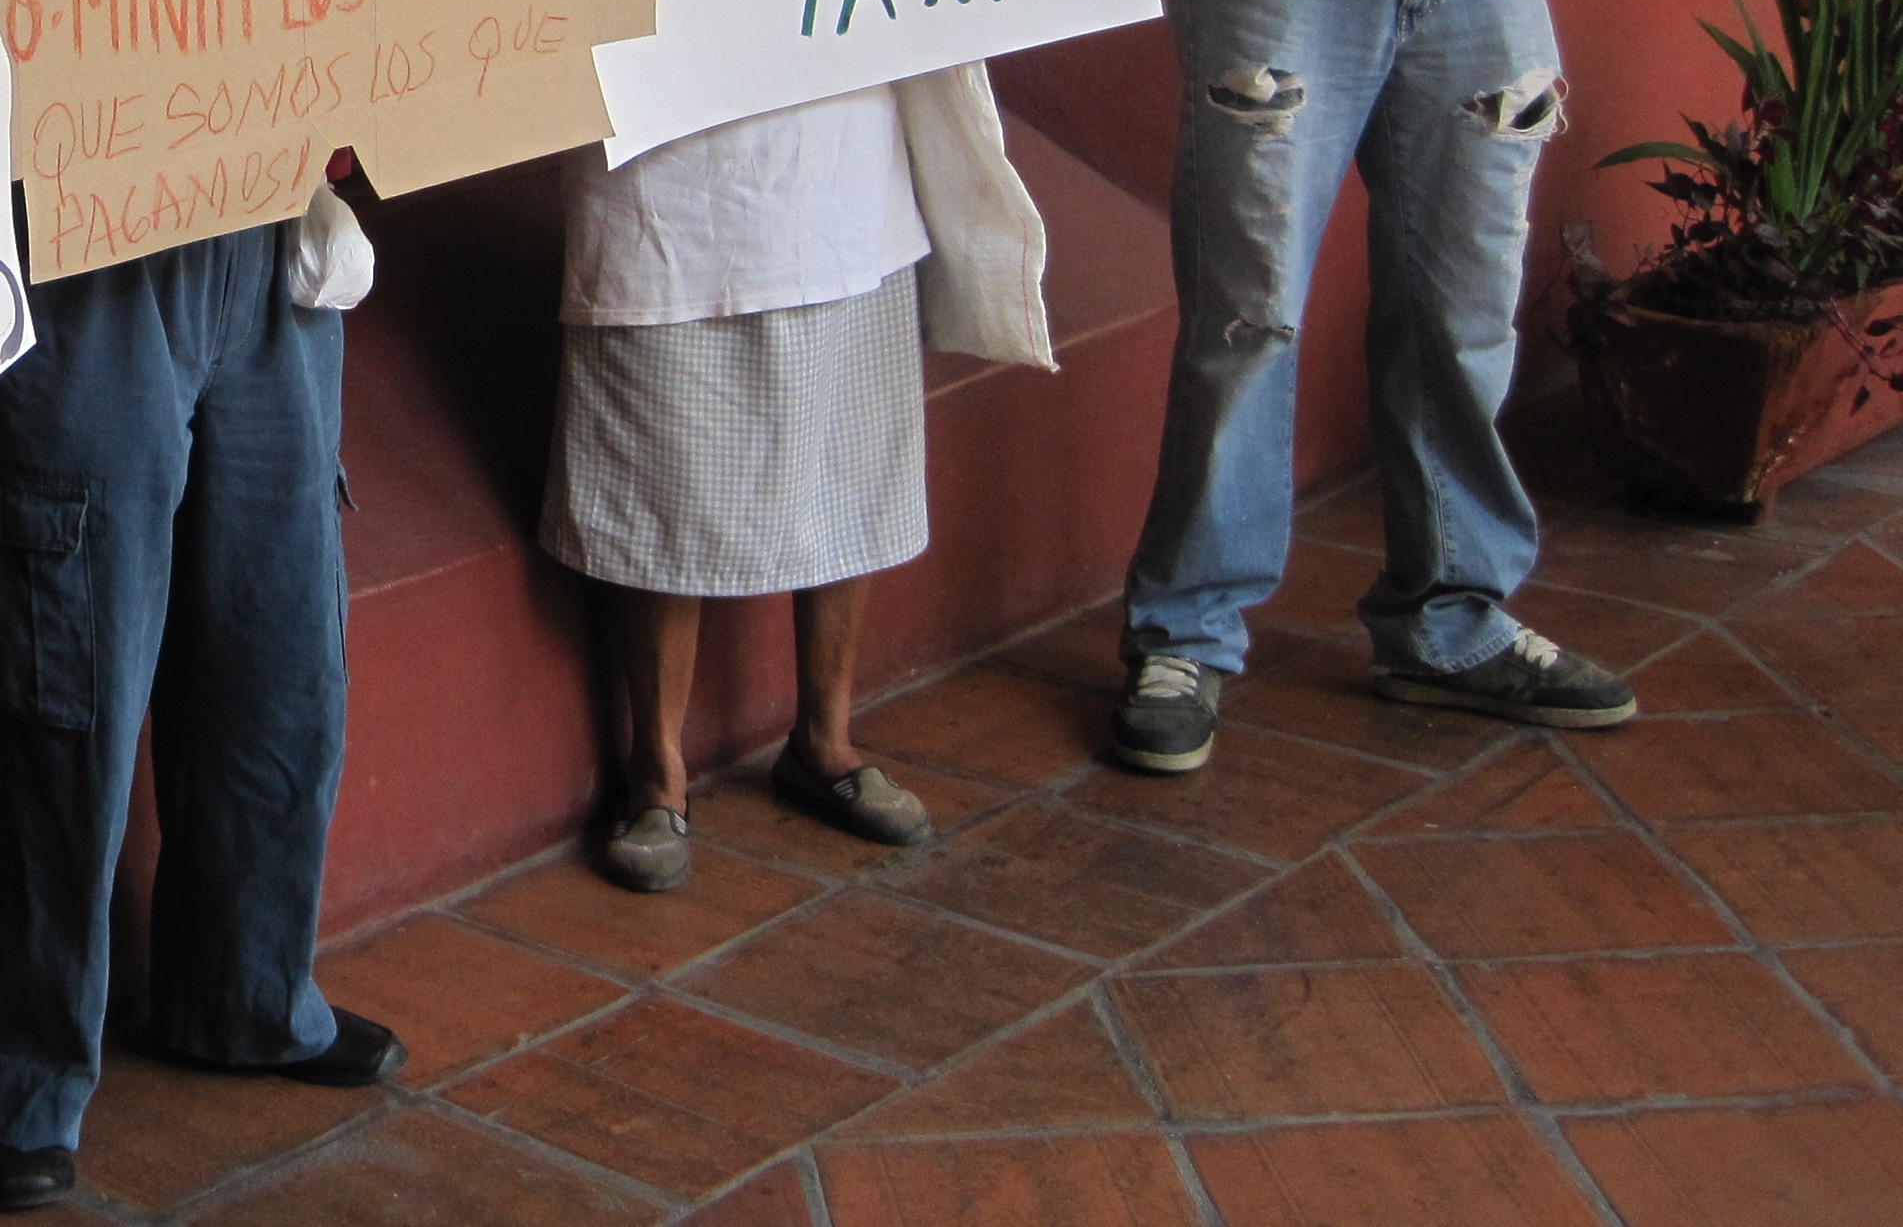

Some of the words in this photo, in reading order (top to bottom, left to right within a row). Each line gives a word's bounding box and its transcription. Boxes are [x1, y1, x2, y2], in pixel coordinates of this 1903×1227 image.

[33, 94, 144, 202] QUE
[166, 52, 351, 149] SOMOS
[370, 30, 435, 102] LOS
[468, 5, 568, 97] QUE
